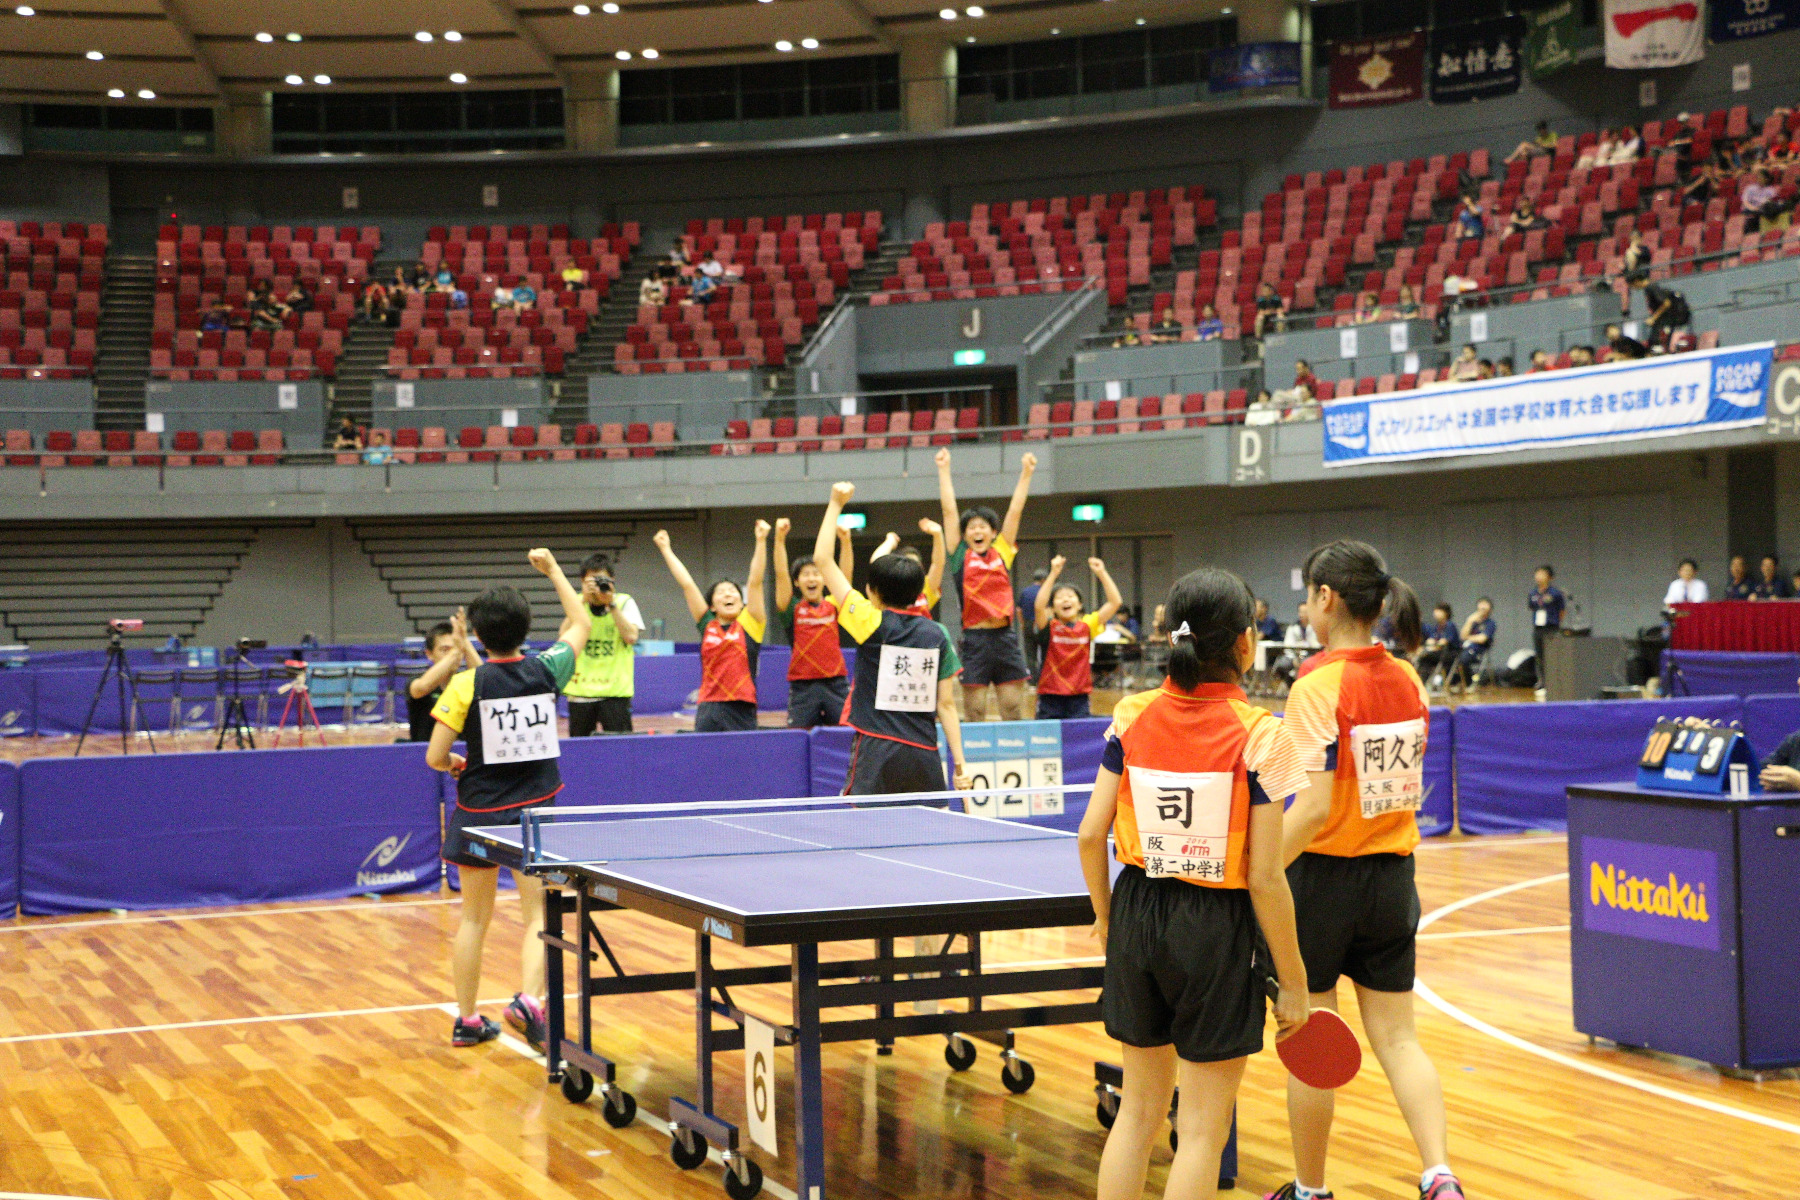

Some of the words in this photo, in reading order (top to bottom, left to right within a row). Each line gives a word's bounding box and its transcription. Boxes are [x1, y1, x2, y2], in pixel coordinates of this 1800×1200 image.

[963, 308, 981, 338] J
[1240, 430, 1262, 466] D
[1235, 466, 1265, 481] コート
[490, 702, 549, 731] 竹山
[1642, 731, 1672, 763] 10
[1003, 771, 1023, 804] 2
[1364, 780, 1394, 795] 大阪
[1156, 786, 1194, 829] 司
[1590, 861, 1710, 922] Nittaku
[753, 1051, 767, 1123] 6
